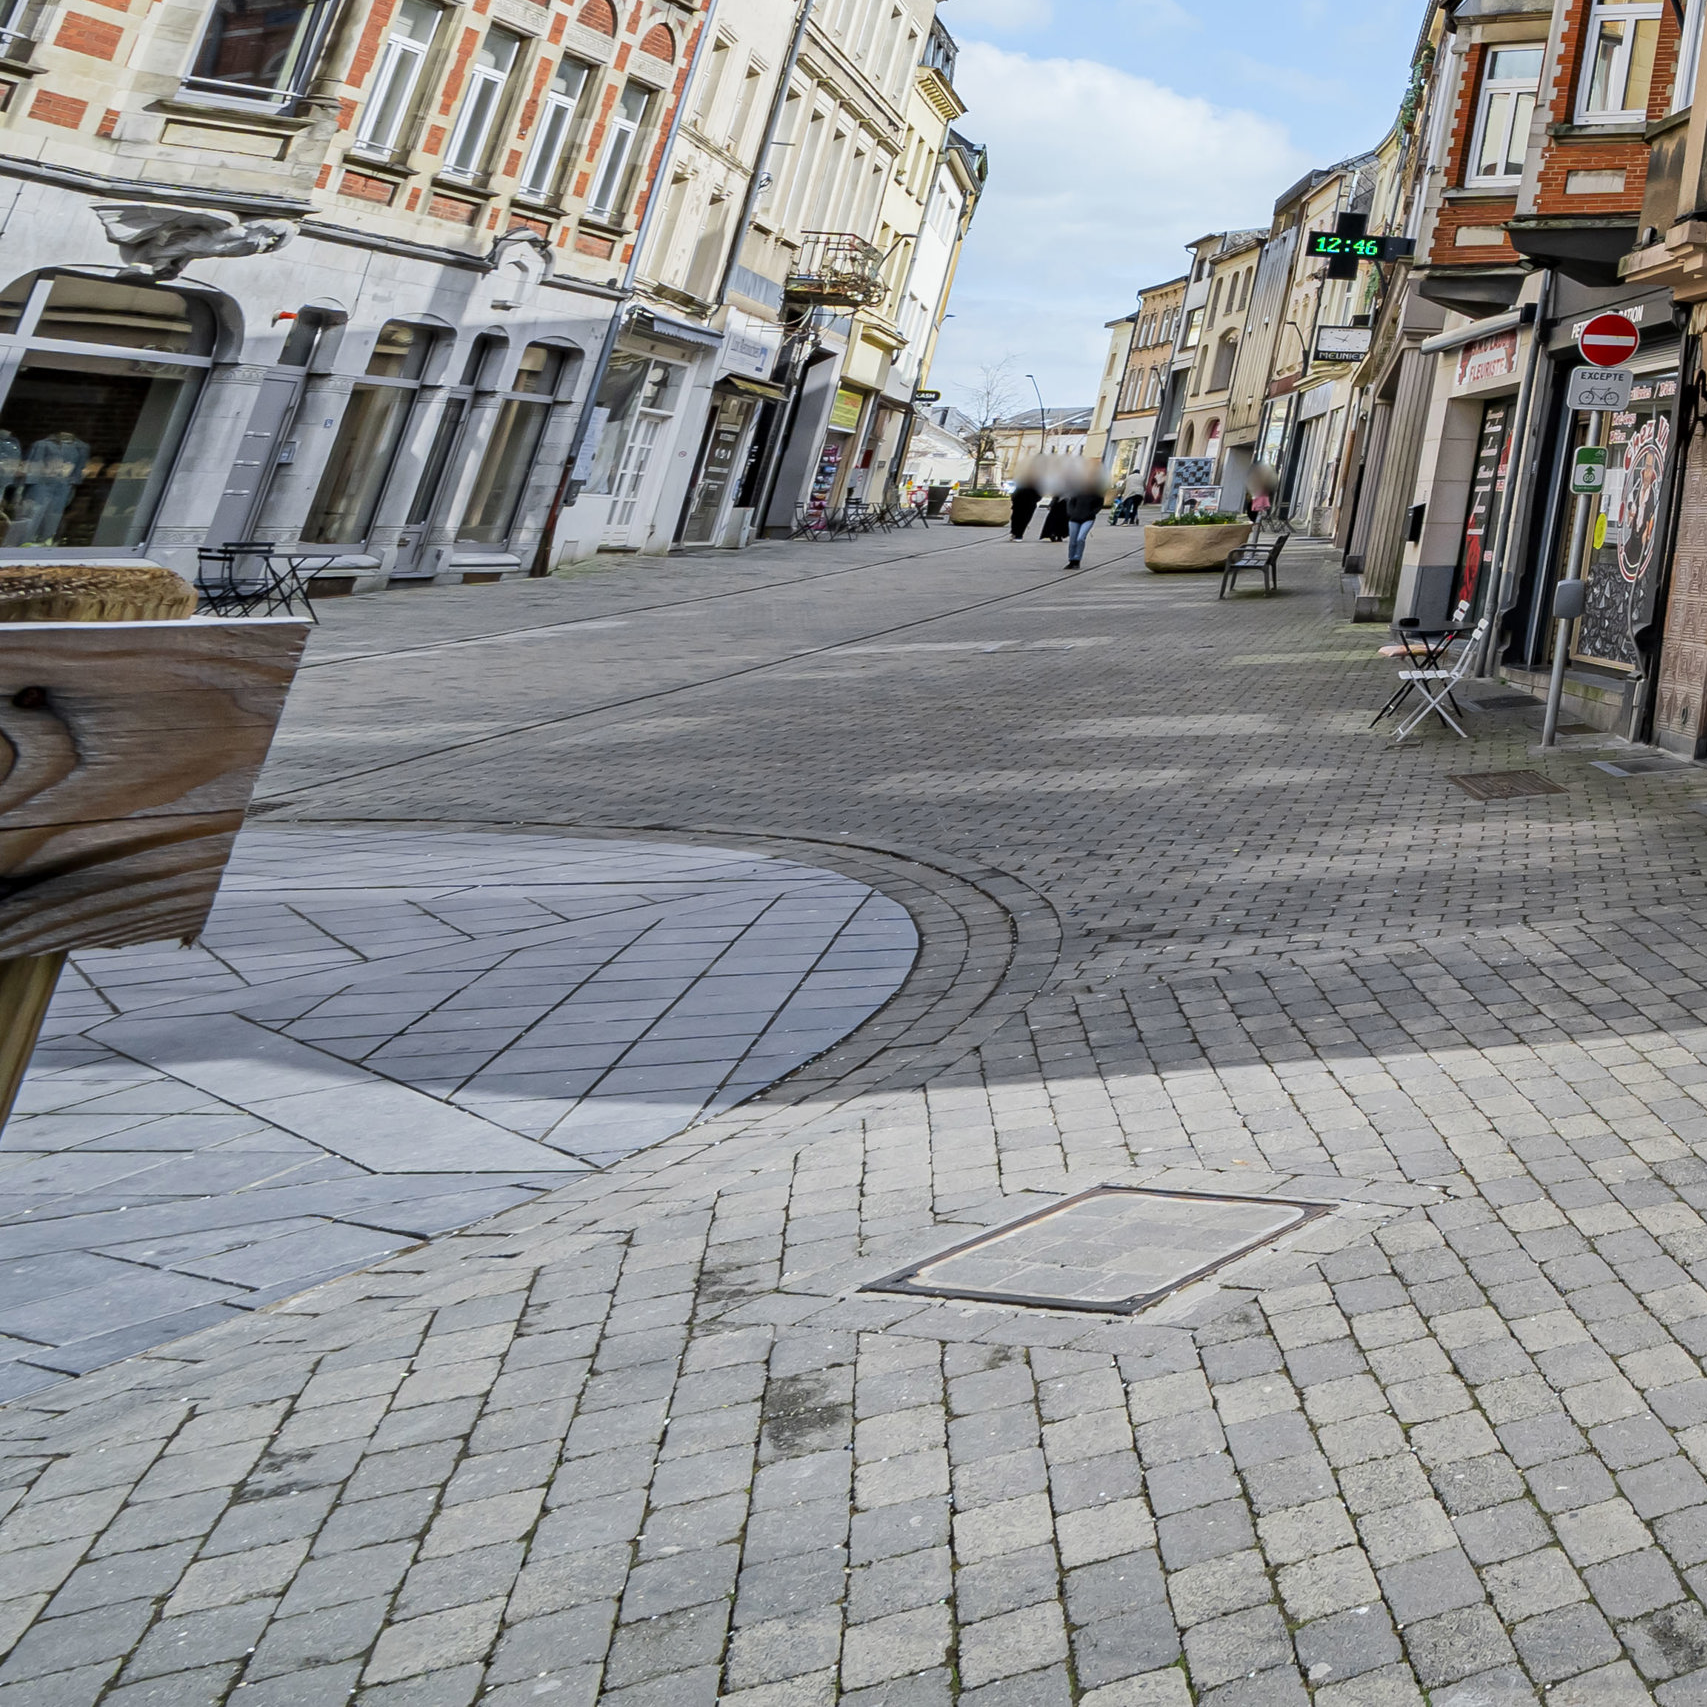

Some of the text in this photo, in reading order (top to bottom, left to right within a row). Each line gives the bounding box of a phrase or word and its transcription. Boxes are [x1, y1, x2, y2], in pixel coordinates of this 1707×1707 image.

[1315, 236, 1378, 255] 12:46
[1318, 351, 1365, 361] MEUNIER
[1469, 357, 1505, 382] FLEURISTE
[1581, 371, 1625, 382] EXCEPTE
[1583, 474, 1594, 482] 69
